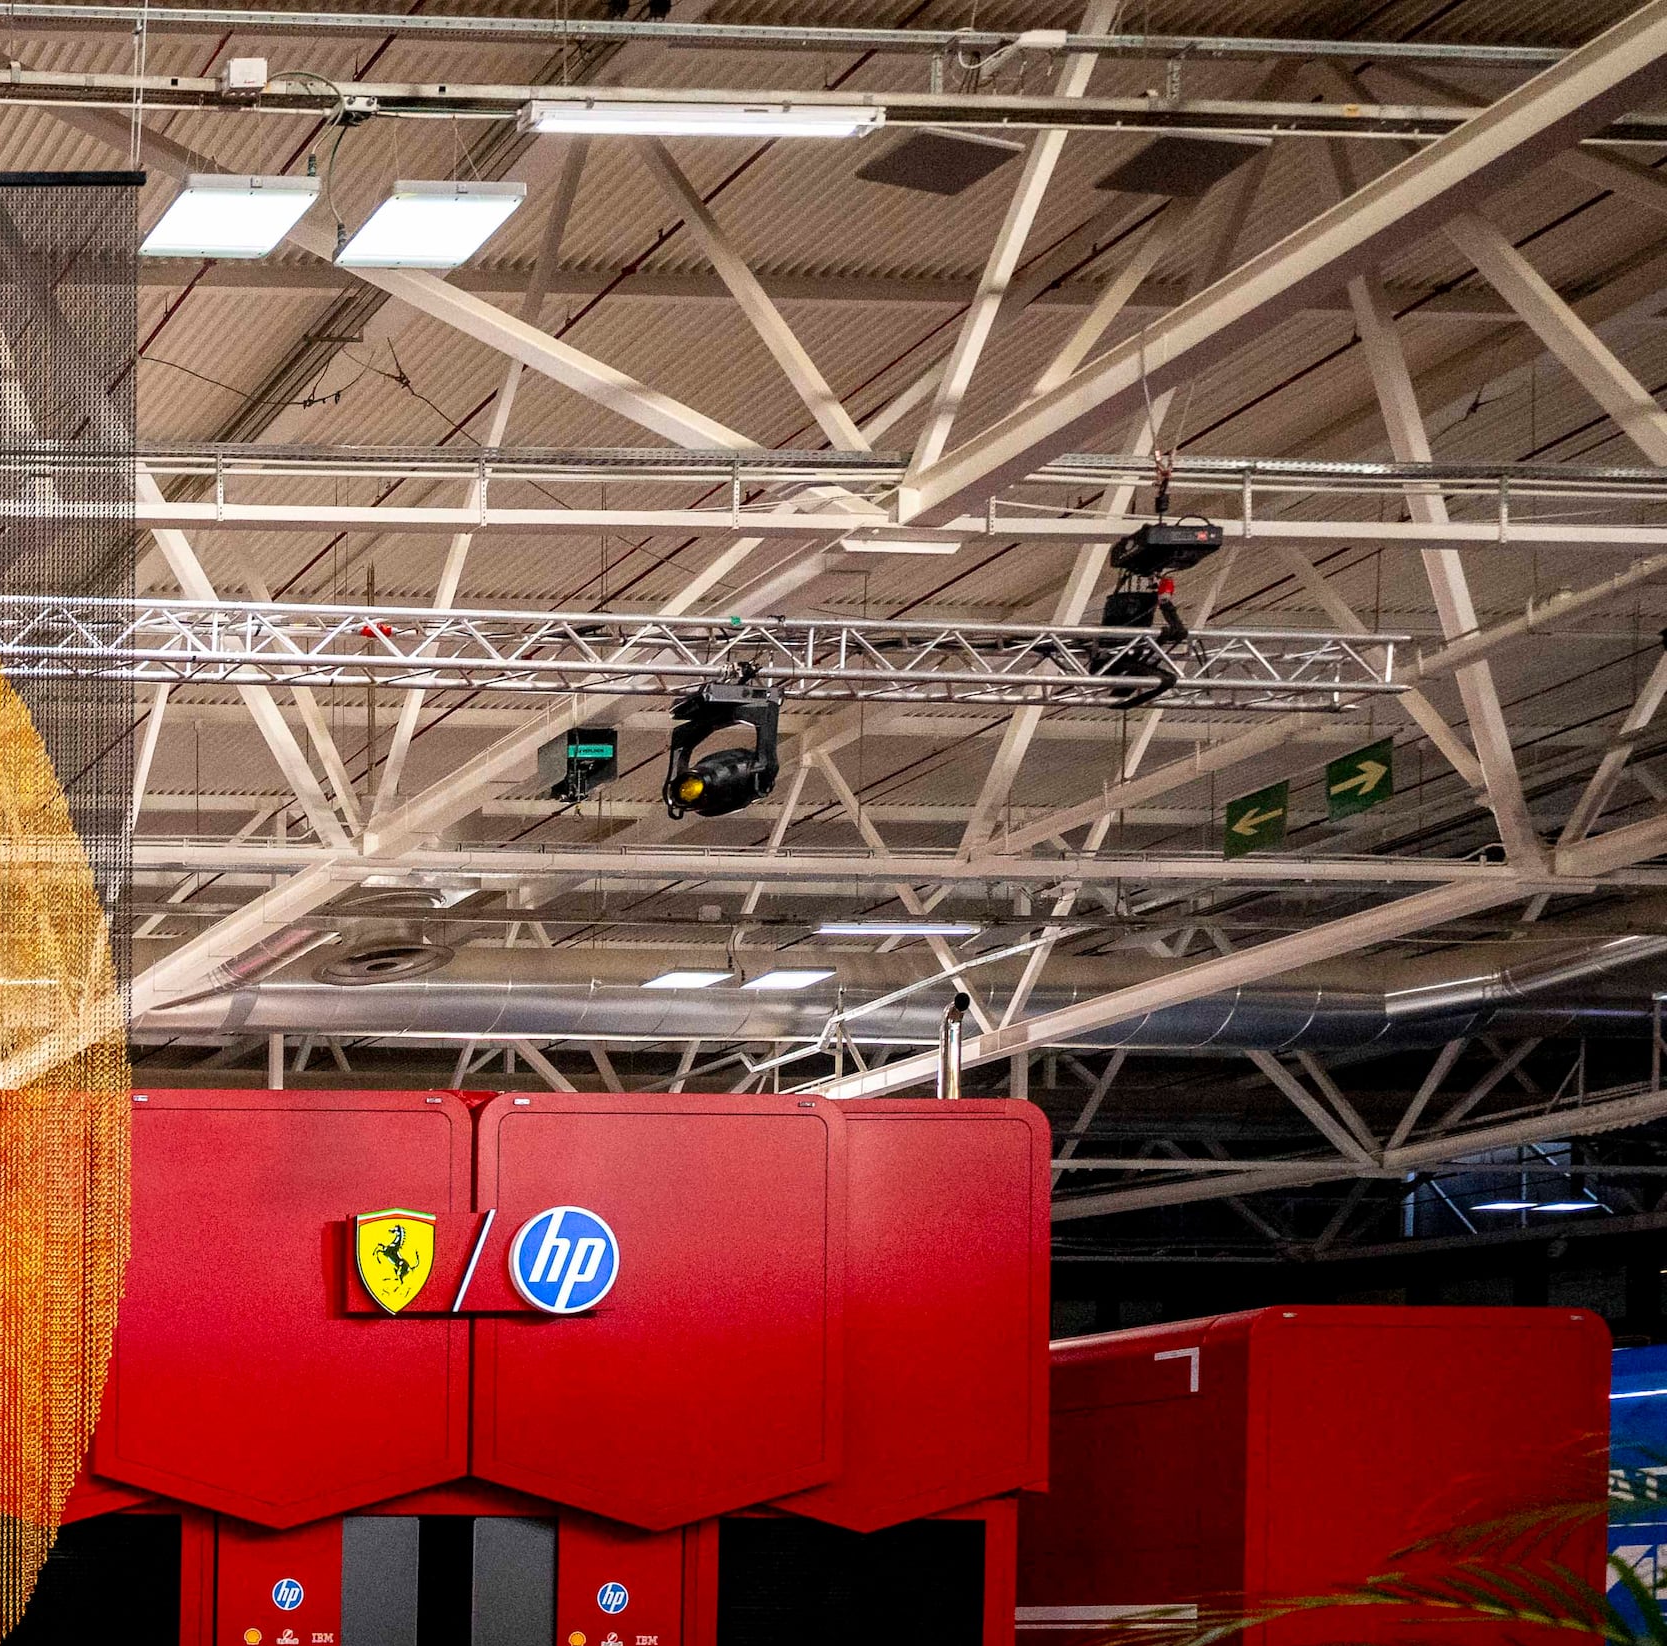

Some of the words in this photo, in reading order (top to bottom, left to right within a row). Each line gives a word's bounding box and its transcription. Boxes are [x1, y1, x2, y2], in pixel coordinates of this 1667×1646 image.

[526, 1208, 607, 1312] hp
[274, 1579, 301, 1610] hp
[599, 1582, 625, 1613] hp
[311, 1633, 334, 1643] IBM
[635, 1635, 658, 1645] IBM
